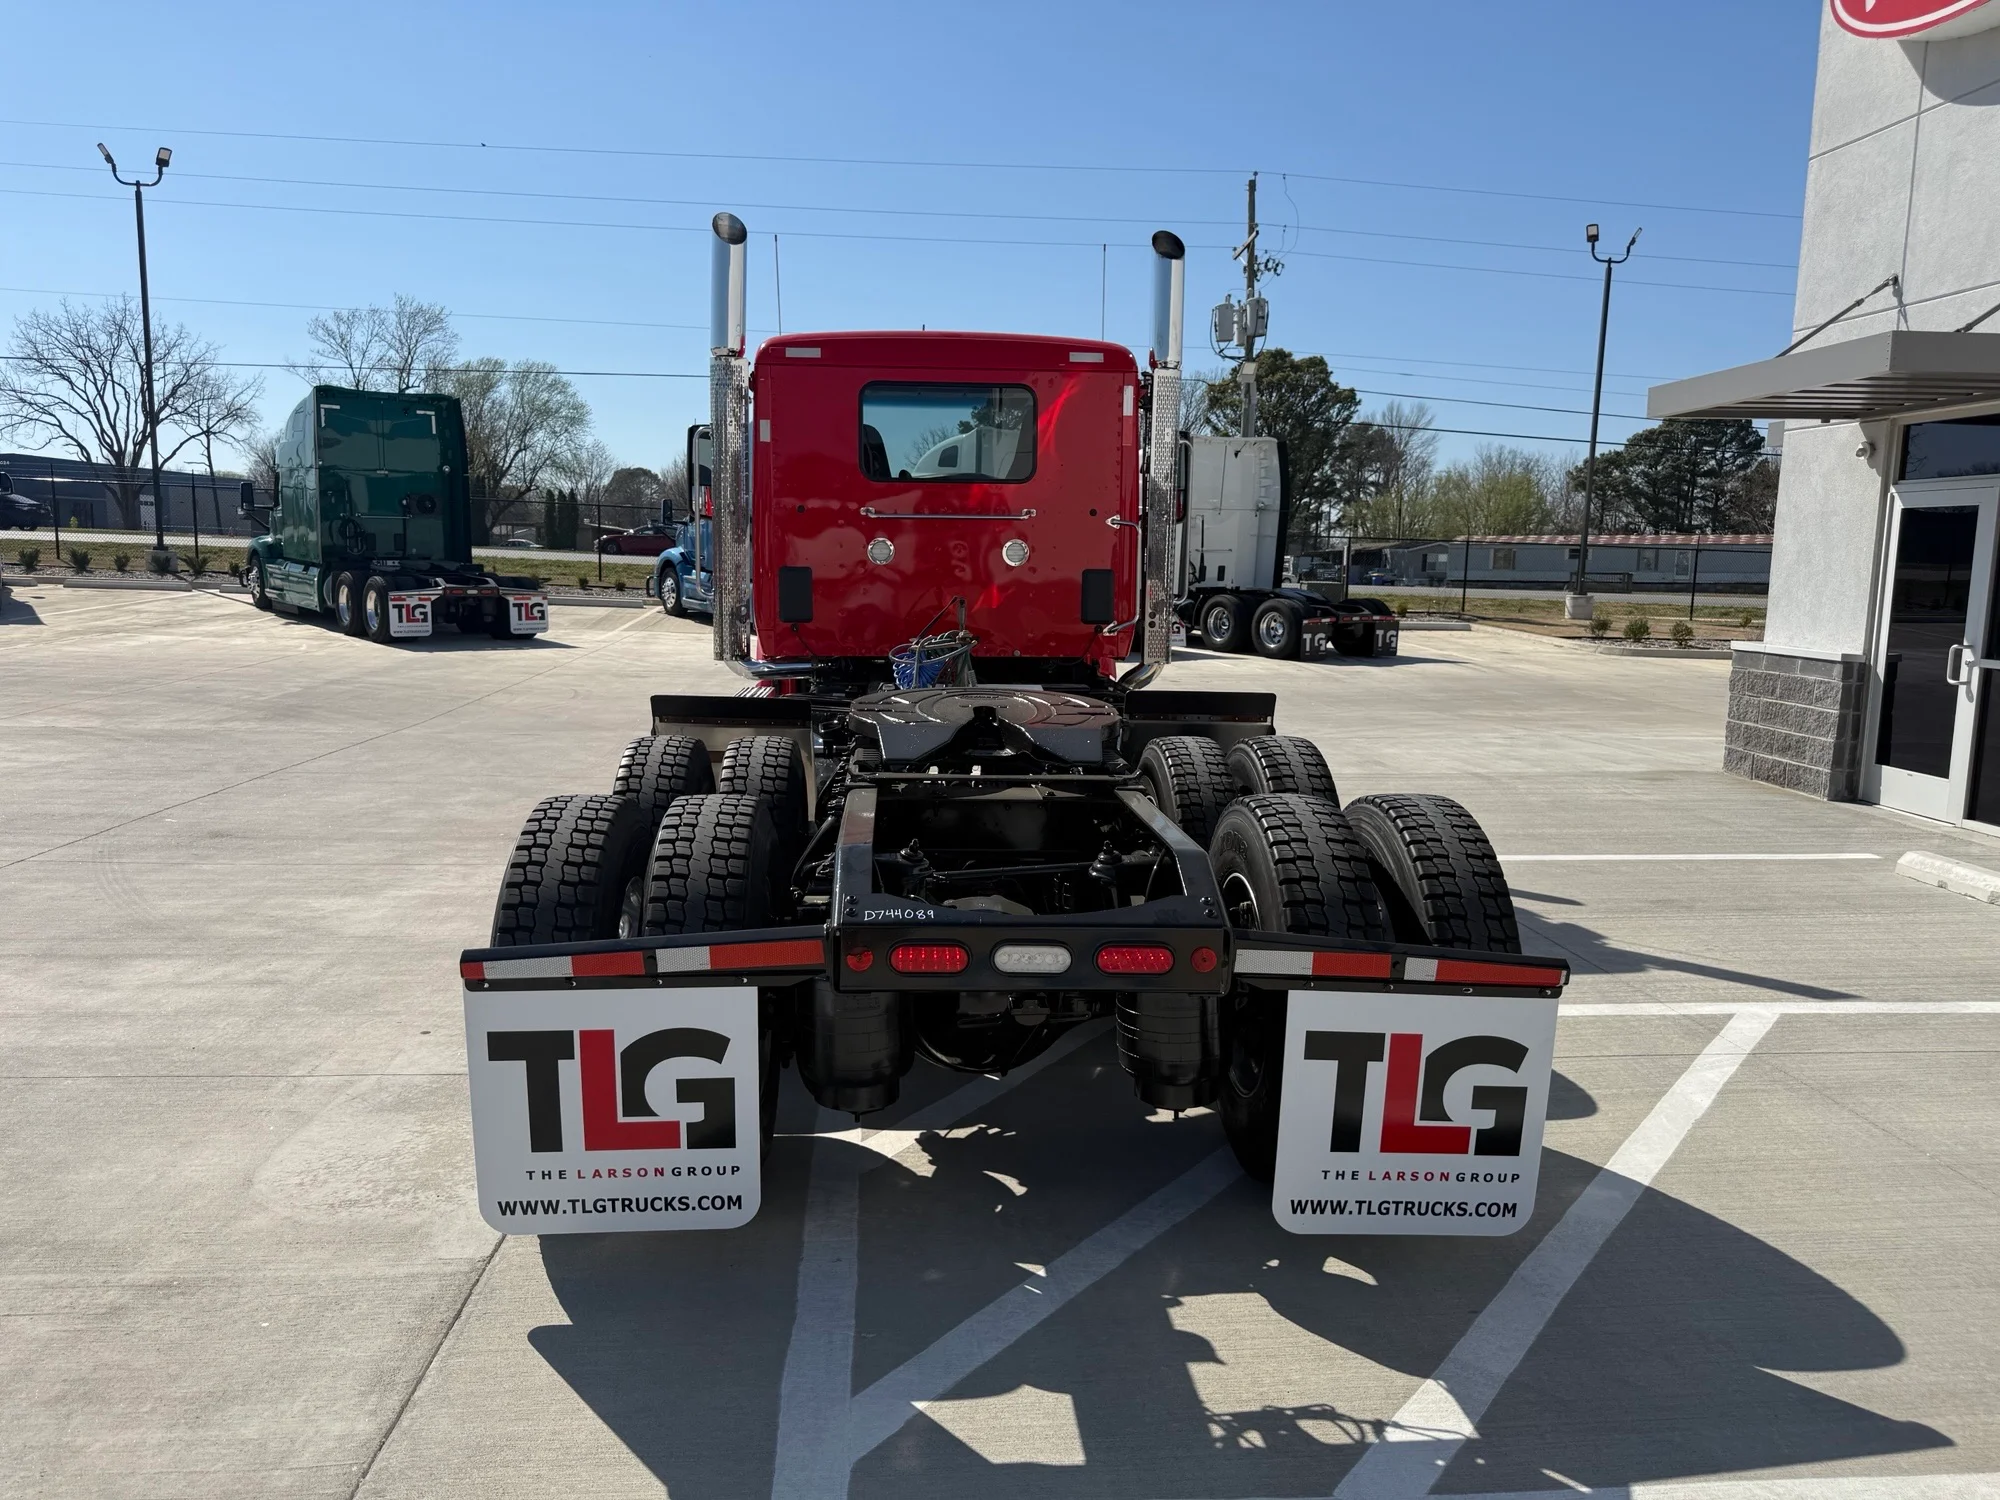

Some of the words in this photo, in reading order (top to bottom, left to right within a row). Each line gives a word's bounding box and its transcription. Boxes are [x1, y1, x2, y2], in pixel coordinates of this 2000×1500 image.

[392, 603, 429, 623] TLG
[512, 602, 546, 622] TLG
[864, 908, 935, 921] D744089
[486, 1027, 737, 1153] TLG
[1304, 1030, 1530, 1157] TLG
[525, 1169, 568, 1181] THE
[1321, 1169, 1360, 1181] THE
[497, 1194, 743, 1217] WWW.TLGTRUCKS.COM
[1290, 1199, 1518, 1219] WWW.TLGTRUCKS.COM
